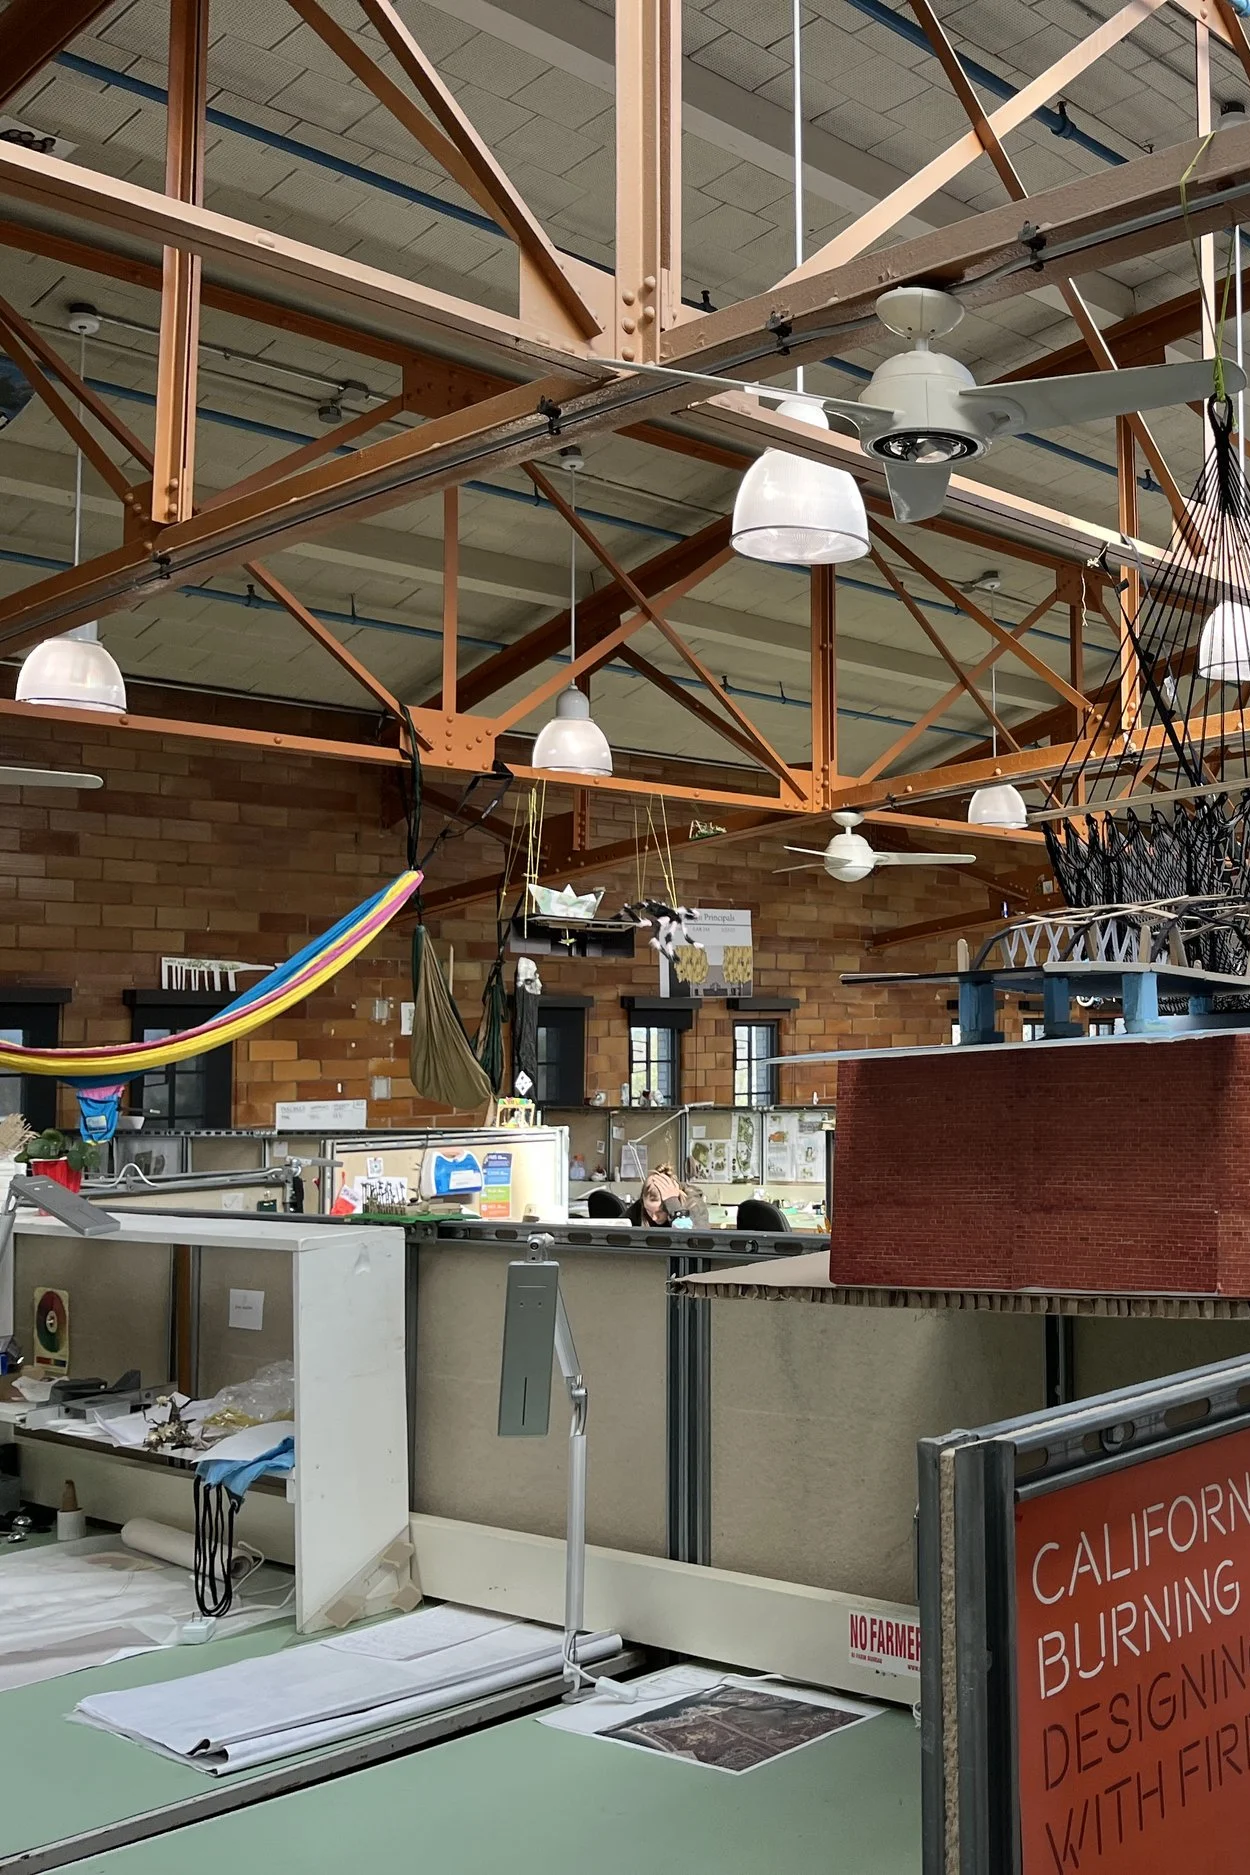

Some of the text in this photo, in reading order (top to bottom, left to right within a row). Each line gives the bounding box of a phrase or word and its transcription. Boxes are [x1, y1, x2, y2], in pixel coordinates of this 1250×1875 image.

[704, 914, 734, 923] Principals
[850, 1613, 868, 1651] NO
[1037, 1559, 1241, 1700] BURNING
[1045, 1760, 1166, 1875] WITH
